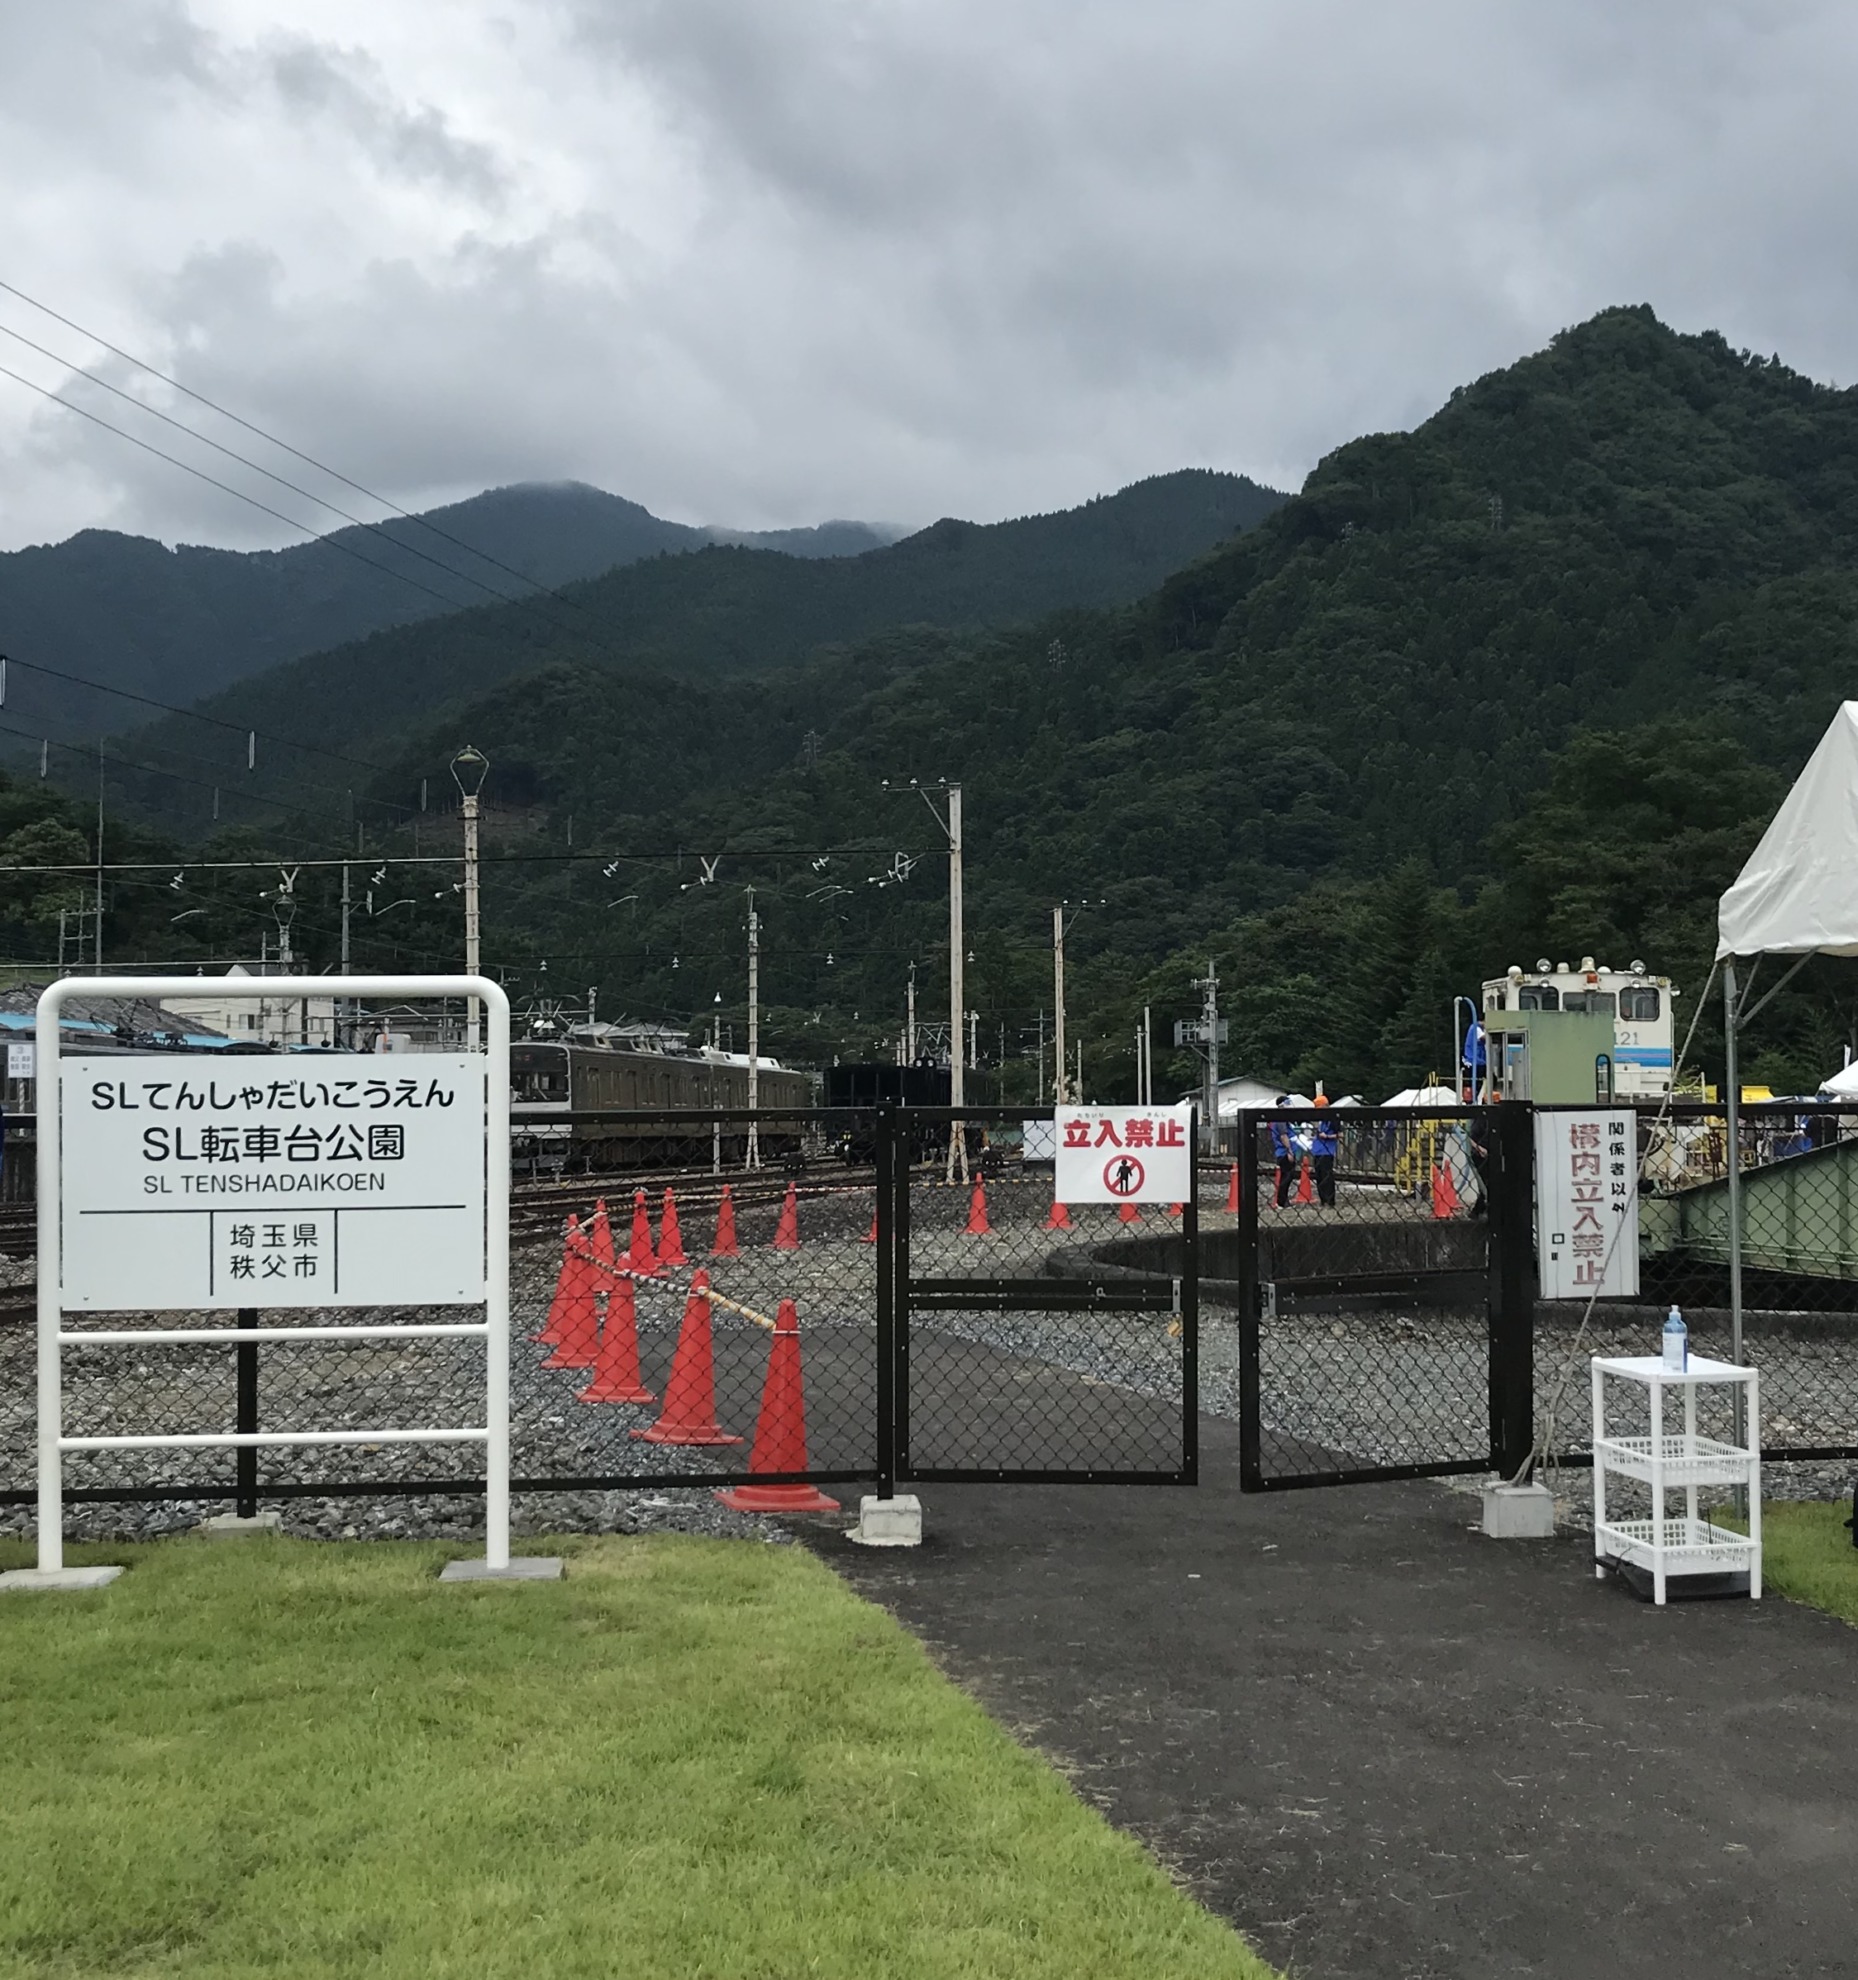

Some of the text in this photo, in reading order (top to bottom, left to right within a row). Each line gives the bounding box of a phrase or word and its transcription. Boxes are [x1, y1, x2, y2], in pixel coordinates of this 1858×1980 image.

[91, 1079, 454, 1110] SLてんしゃだいこうえん
[142, 1124, 404, 1163] SL転車台公園
[1063, 1119, 1185, 1148] 立入禁止
[143, 1172, 385, 1194] SL TENSHADAIKOEN
[230, 1224, 318, 1248] 埼玉県
[230, 1254, 318, 1279] 秩父市
